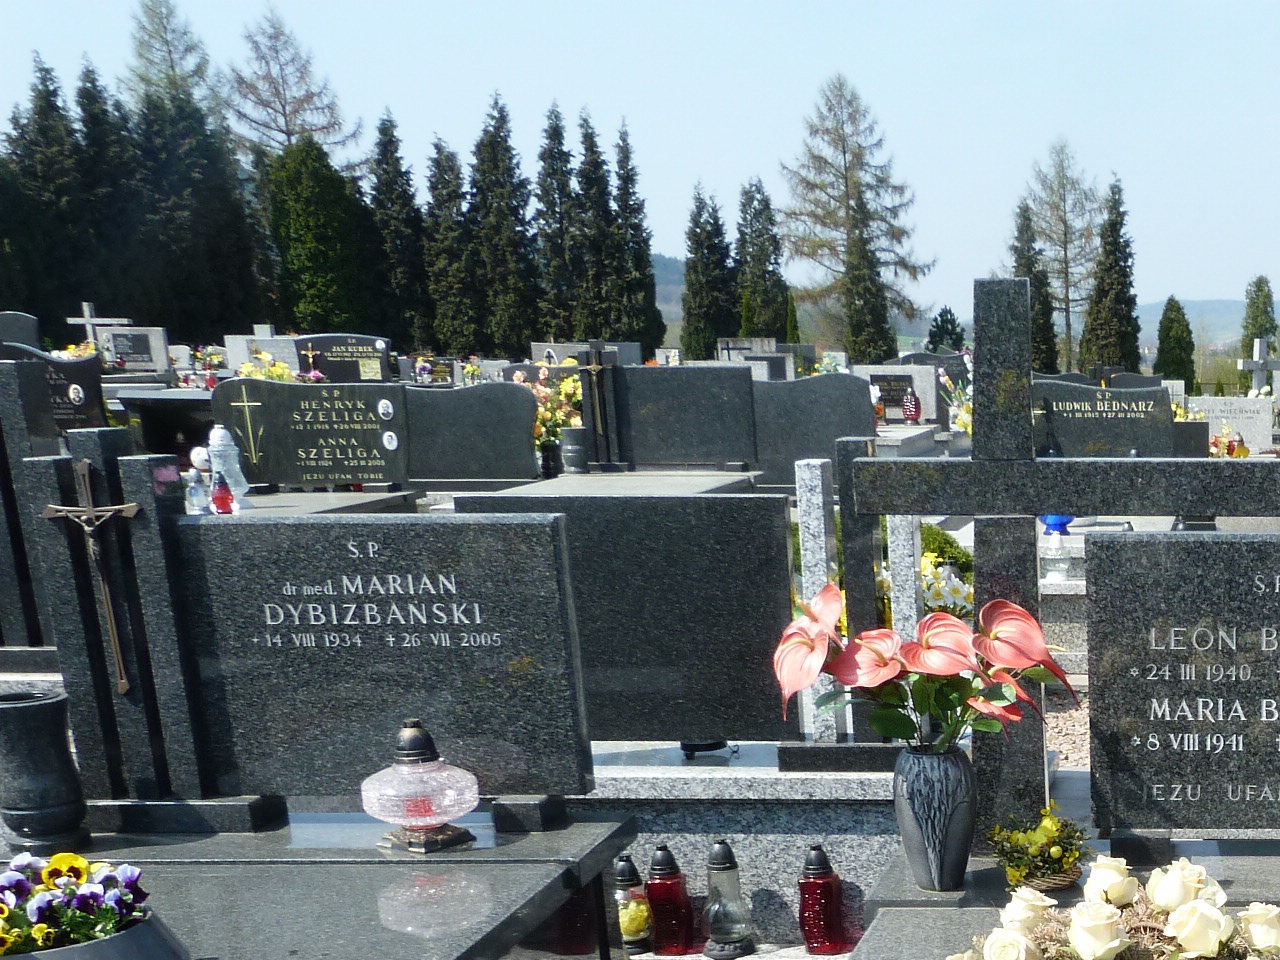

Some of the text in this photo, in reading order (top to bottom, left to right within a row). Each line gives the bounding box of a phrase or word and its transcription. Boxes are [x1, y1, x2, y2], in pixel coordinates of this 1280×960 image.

[300, 400, 366, 409] HENRYK
[1052, 401, 1155, 411] LUDWIK BEDNARZ
[292, 411, 377, 421] SZELIGA
[318, 438, 359, 446] ANNA
[297, 448, 381, 458] SZELIGA
[302, 473, 325, 481] JEZU
[282, 574, 458, 596] dr med. MARIAN
[263, 600, 482, 625] DYBIZBAŃSKI
[265, 633, 502, 647] 14 VIII 1934 26 VII 2005
[1149, 627, 1238, 651] LEON
[1146, 664, 1171, 681] 24
[1180, 664, 1196, 681] III
[1206, 664, 1251, 681] 1940
[1149, 698, 1248, 723] MARIA
[1146, 733, 1160, 751] 8
[1168, 733, 1199, 751] VIII
[1205, 733, 1244, 754] 1941
